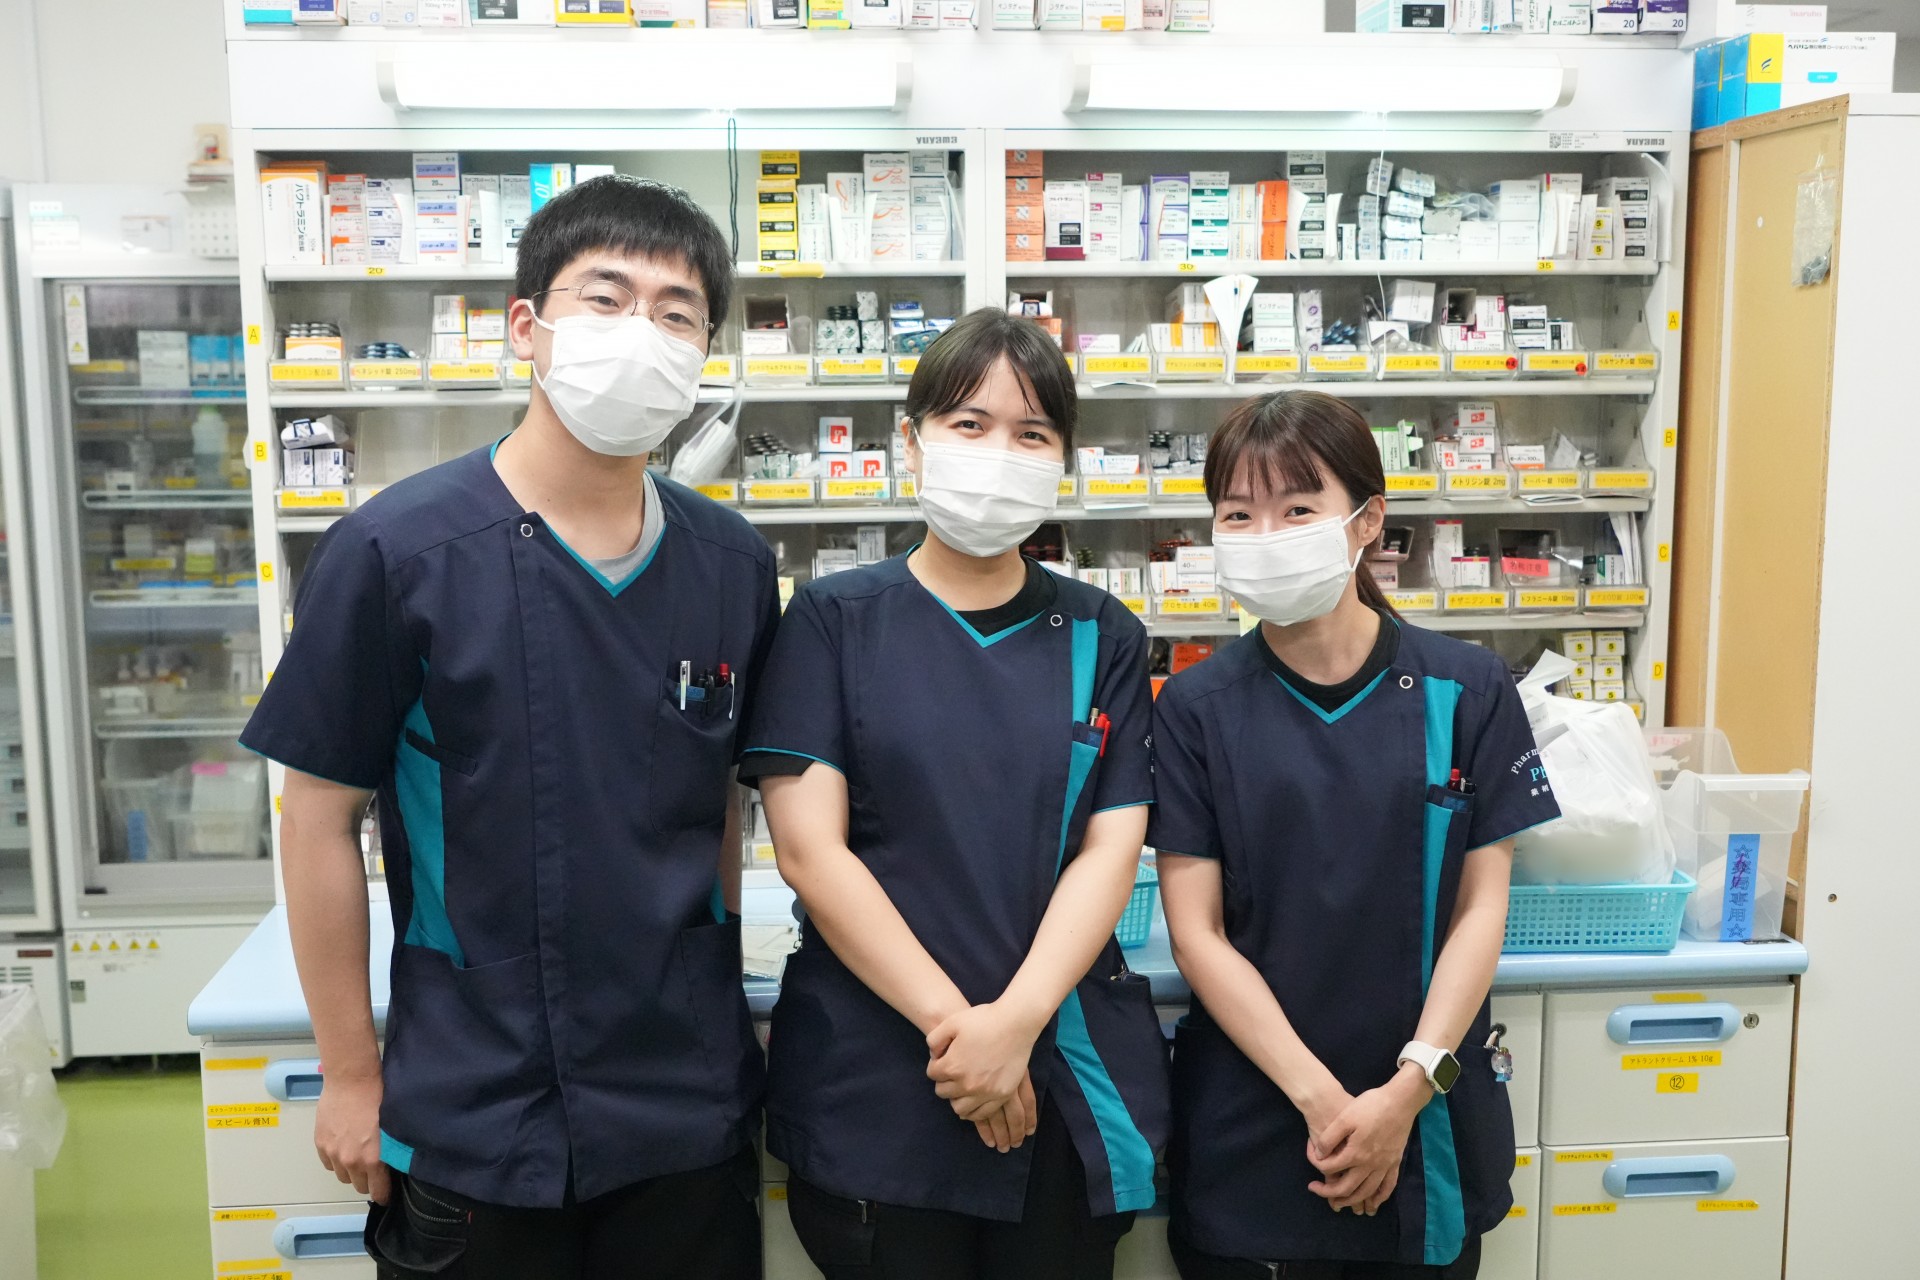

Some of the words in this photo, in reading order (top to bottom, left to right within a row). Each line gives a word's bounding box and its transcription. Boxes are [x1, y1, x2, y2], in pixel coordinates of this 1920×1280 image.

[1622, 18, 1634, 28] 20
[1672, 18, 1684, 28] 20
[916, 136, 958, 145] yuyama
[1626, 137, 1665, 146] yuyama
[1538, 262, 1552, 270] 35
[1669, 314, 1677, 326] A
[249, 328, 258, 339] A
[1665, 431, 1673, 444] B
[256, 444, 264, 457] B
[1452, 477, 1490, 486] メトリジン錠
[262, 564, 271, 578] C
[1629, 1056, 1684, 1065] アトラントクリーム
[1700, 1055, 1714, 1063] 10g
